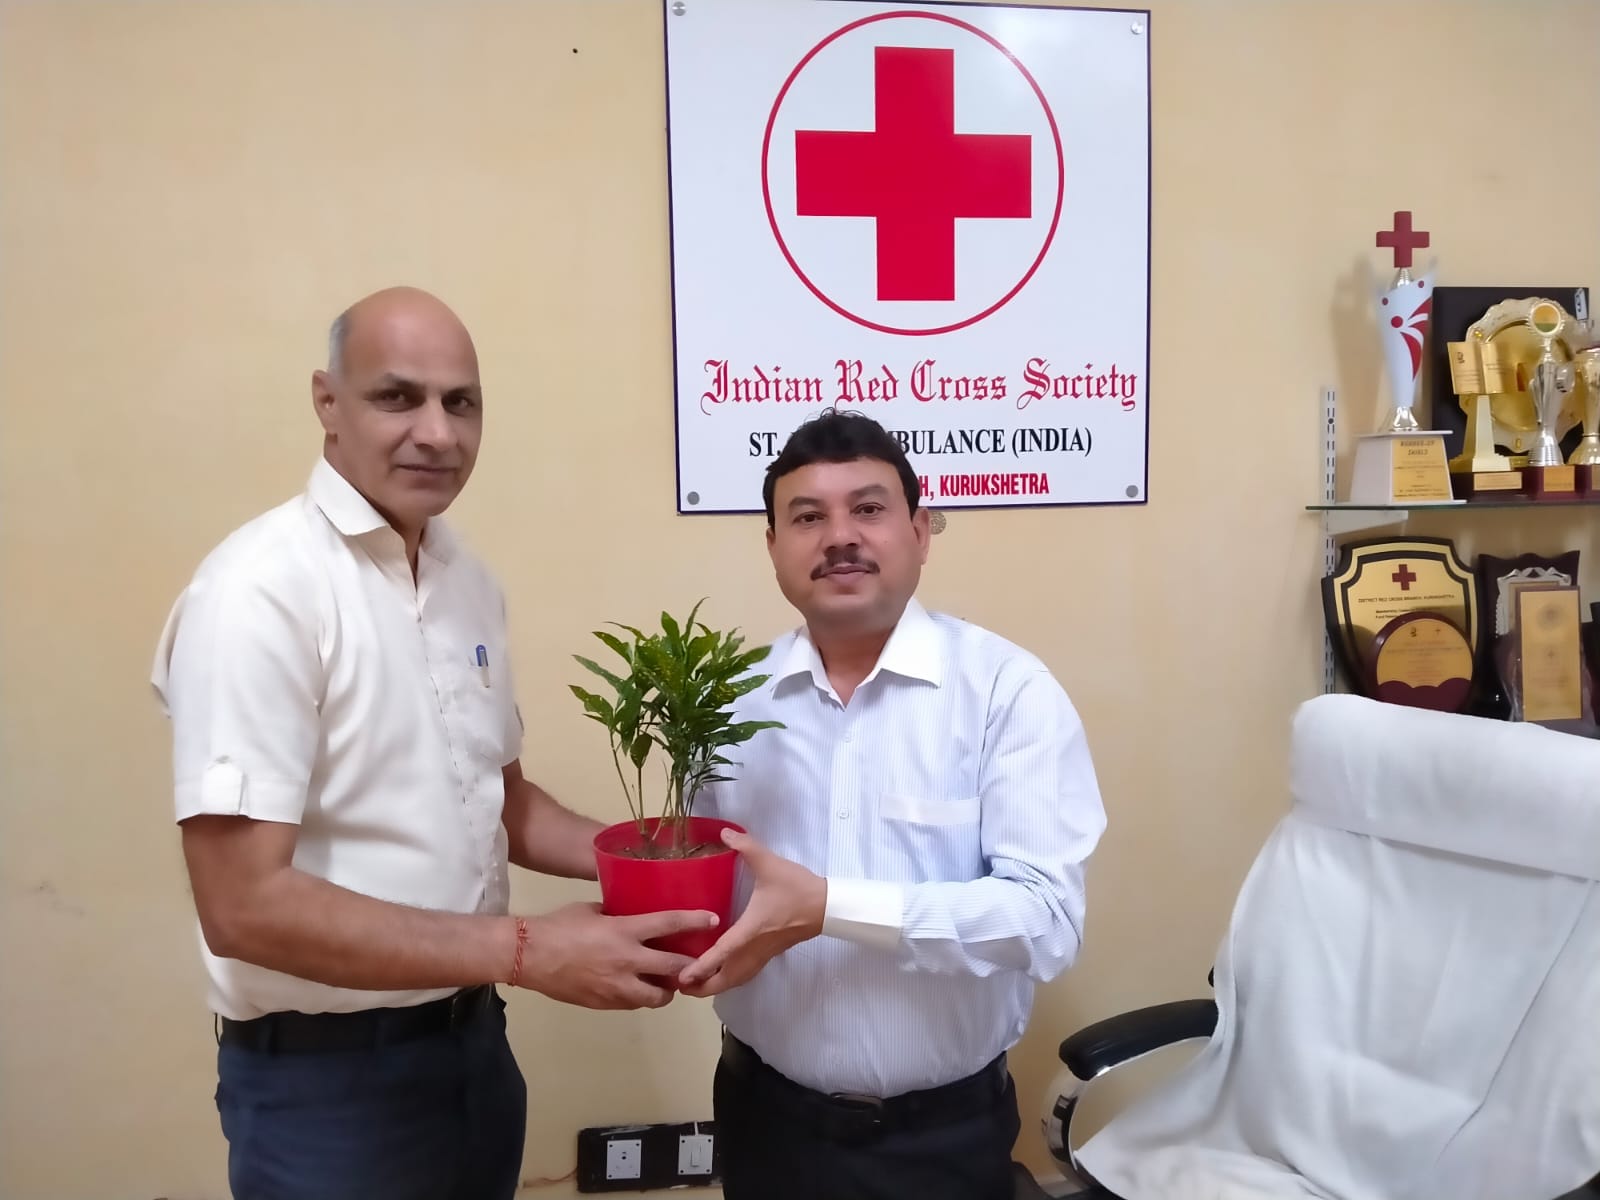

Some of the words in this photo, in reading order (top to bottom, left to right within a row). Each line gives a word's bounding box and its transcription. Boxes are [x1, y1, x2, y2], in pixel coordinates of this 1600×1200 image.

[700, 360, 823, 415] Indian
[834, 360, 899, 411] Red
[911, 359, 1006, 402] Cross
[1017, 358, 1137, 411] Society
[749, 432, 781, 457] ST.
[890, 429, 1005, 455] BULANCE
[1012, 427, 1092, 458] (INDIA)
[940, 473, 1050, 496] KURUKSHETRA
